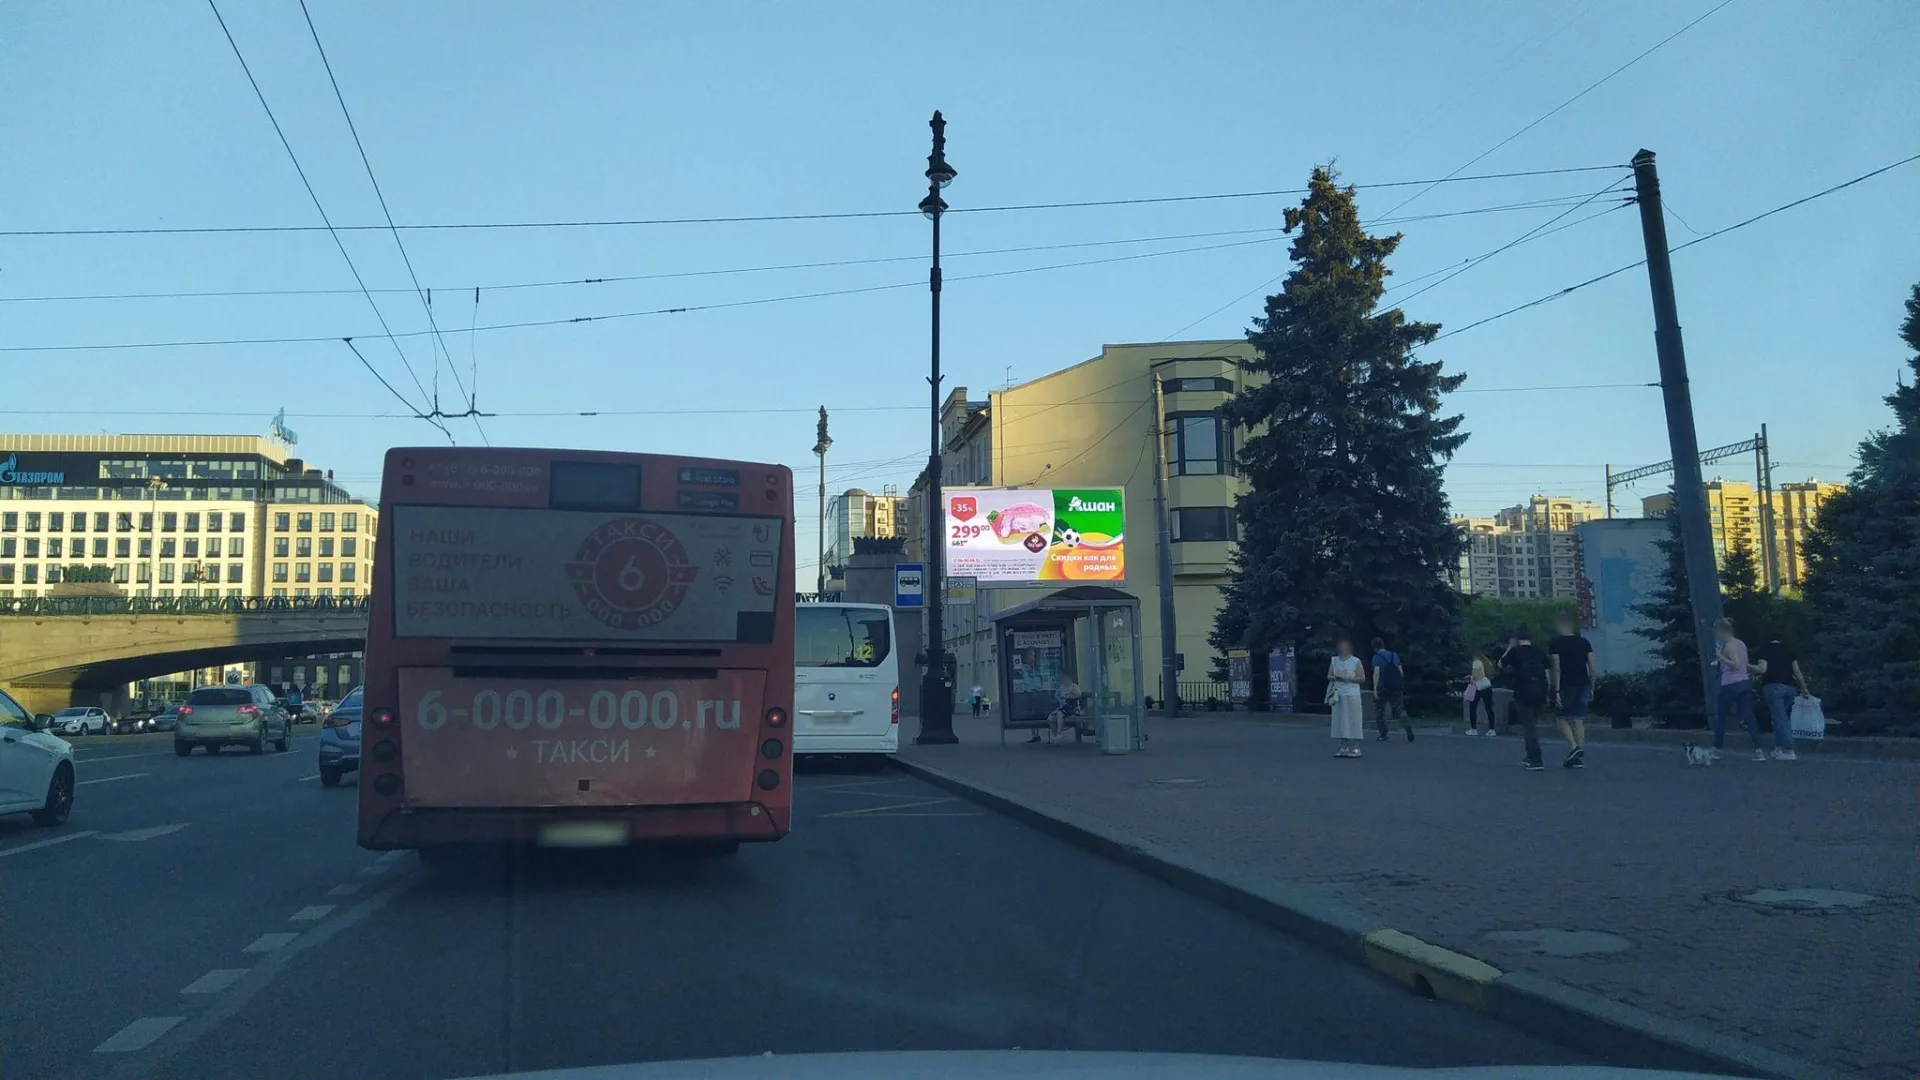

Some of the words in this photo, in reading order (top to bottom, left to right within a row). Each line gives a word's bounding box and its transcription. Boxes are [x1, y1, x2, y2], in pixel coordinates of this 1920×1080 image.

[16, 472, 65, 484] ГАЗПРОМ
[1068, 496, 1116, 512] Ашан
[409, 527, 476, 546] НАШИ
[590, 520, 675, 551] ТАКСИ
[952, 525, 981, 539] 299
[408, 552, 523, 571] ВОДИТЕЛИ
[1083, 564, 1117, 572] родных
[618, 554, 646, 592] 6
[408, 576, 471, 594] ВАША
[406, 600, 572, 620] БЕЗОПАСНОСТЬ
[417, 689, 742, 732] 6-000-000.ru
[532, 739, 630, 764] ТАКСИ
